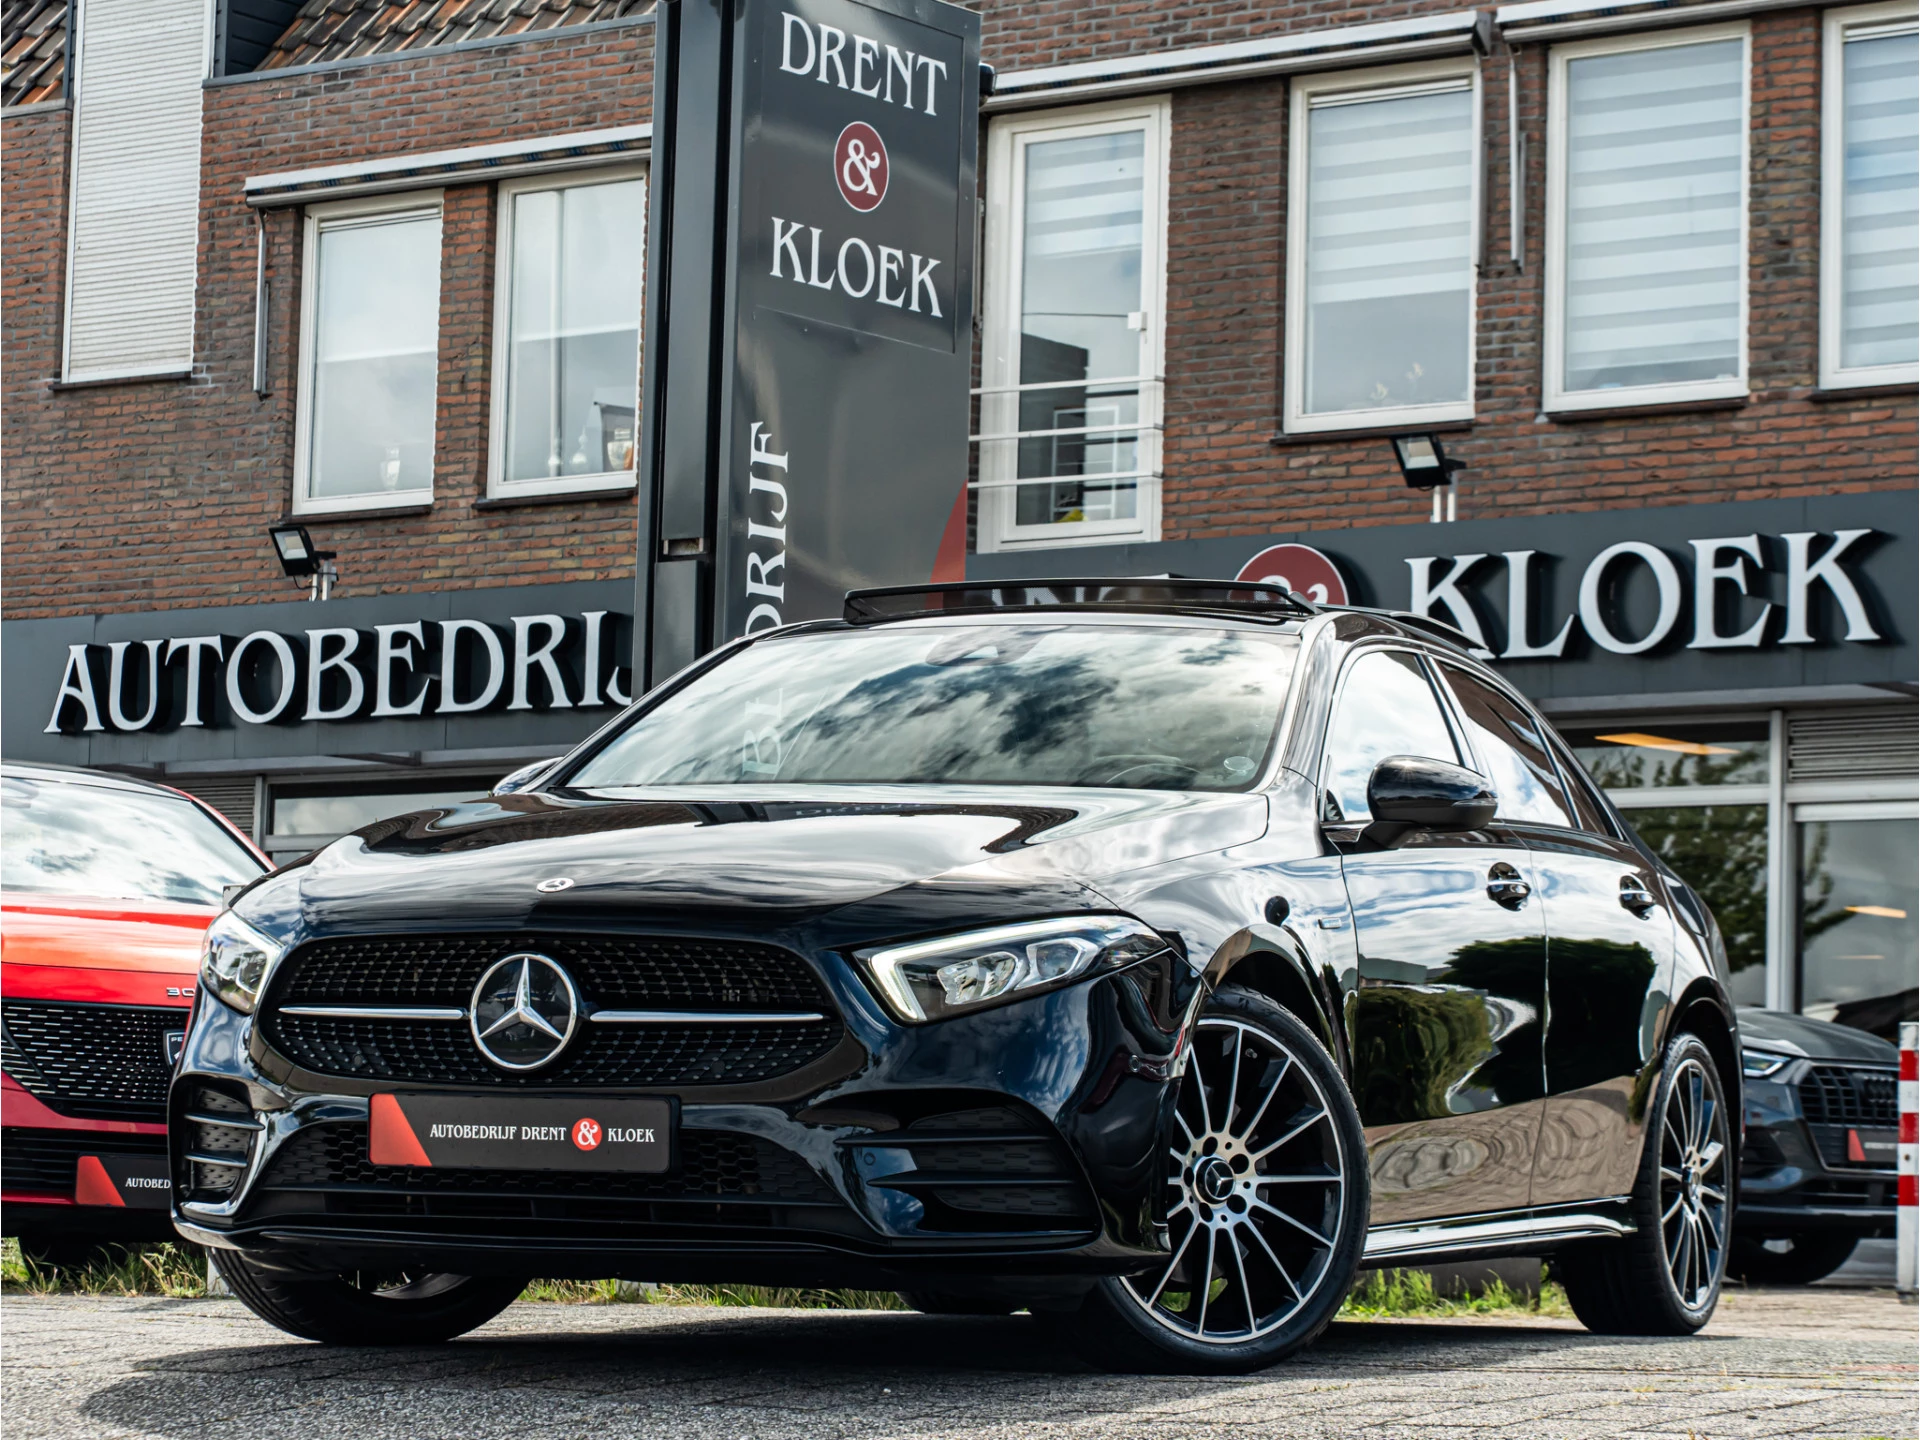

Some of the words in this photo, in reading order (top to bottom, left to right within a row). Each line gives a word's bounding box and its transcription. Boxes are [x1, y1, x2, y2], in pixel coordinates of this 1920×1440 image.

[779, 11, 947, 117] DRENT
[842, 138, 881, 196] &
[769, 216, 943, 318] KLOEK
[1404, 529, 1881, 660] KLOEK
[429, 1123, 518, 1140] AUTOBEDRIJF
[521, 1126, 567, 1141] DRENT
[577, 1121, 599, 1146] &
[607, 1127, 655, 1143] KLOEK
